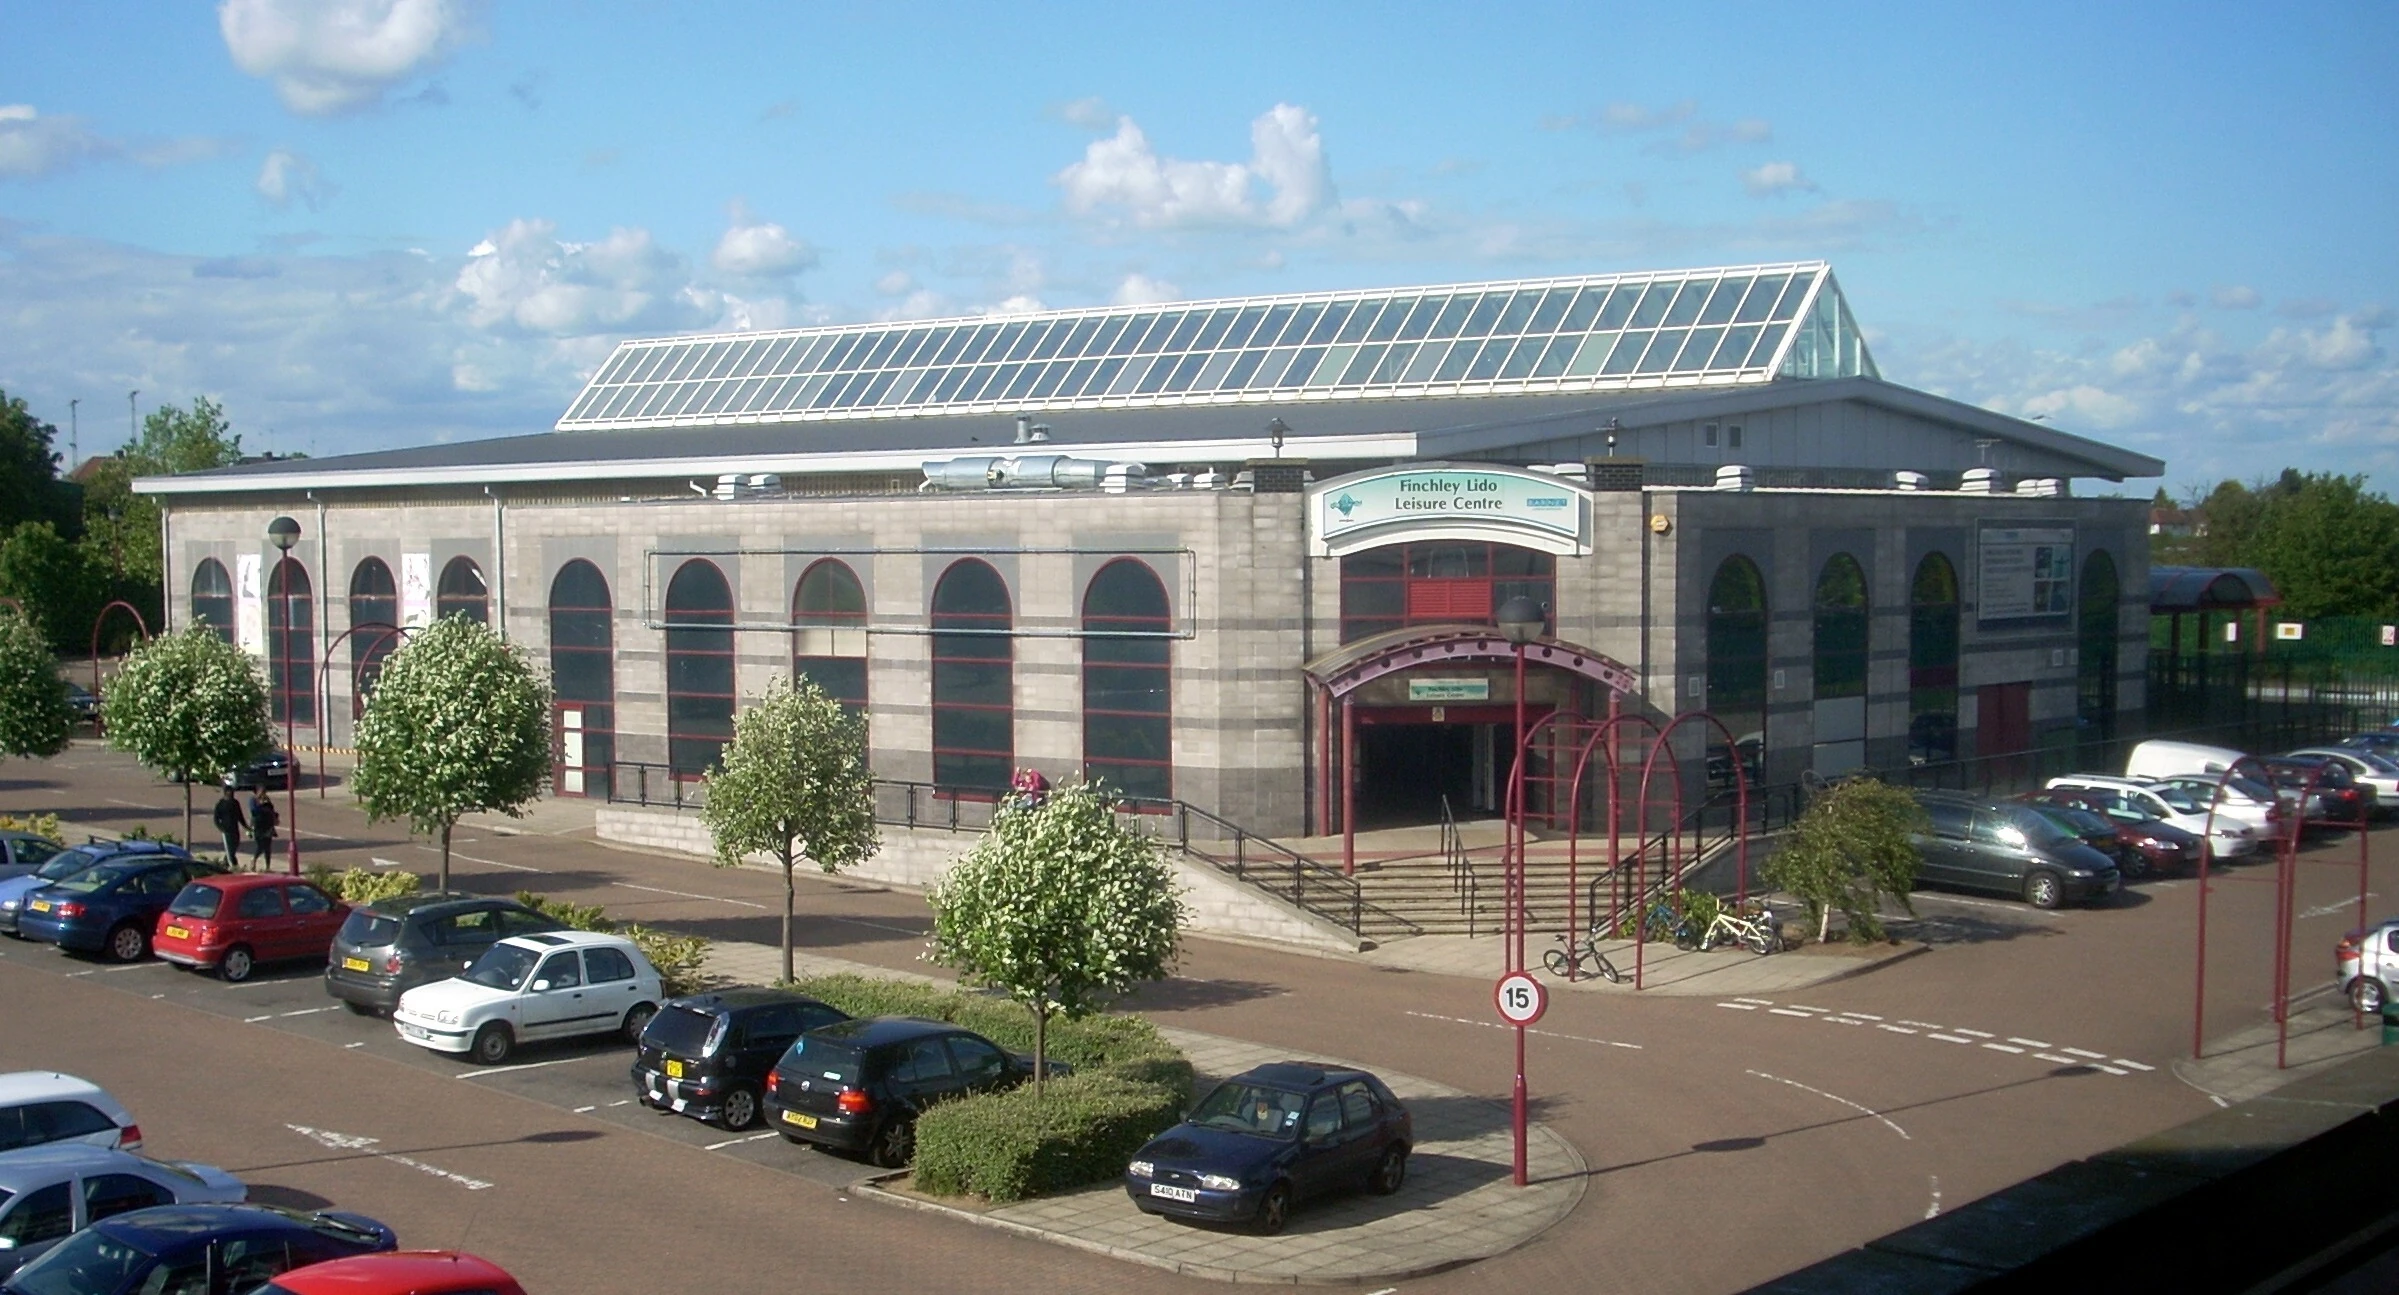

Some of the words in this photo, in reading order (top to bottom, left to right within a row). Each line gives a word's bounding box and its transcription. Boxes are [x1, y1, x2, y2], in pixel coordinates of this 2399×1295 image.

[1400, 478, 1460, 495] Finchley
[1467, 478, 1498, 492] Lido
[1395, 497, 1447, 510] Leisure
[1453, 496, 1503, 510] Centre
[1505, 987, 1530, 1009] 15
[1175, 1189, 1193, 1200] ATN
